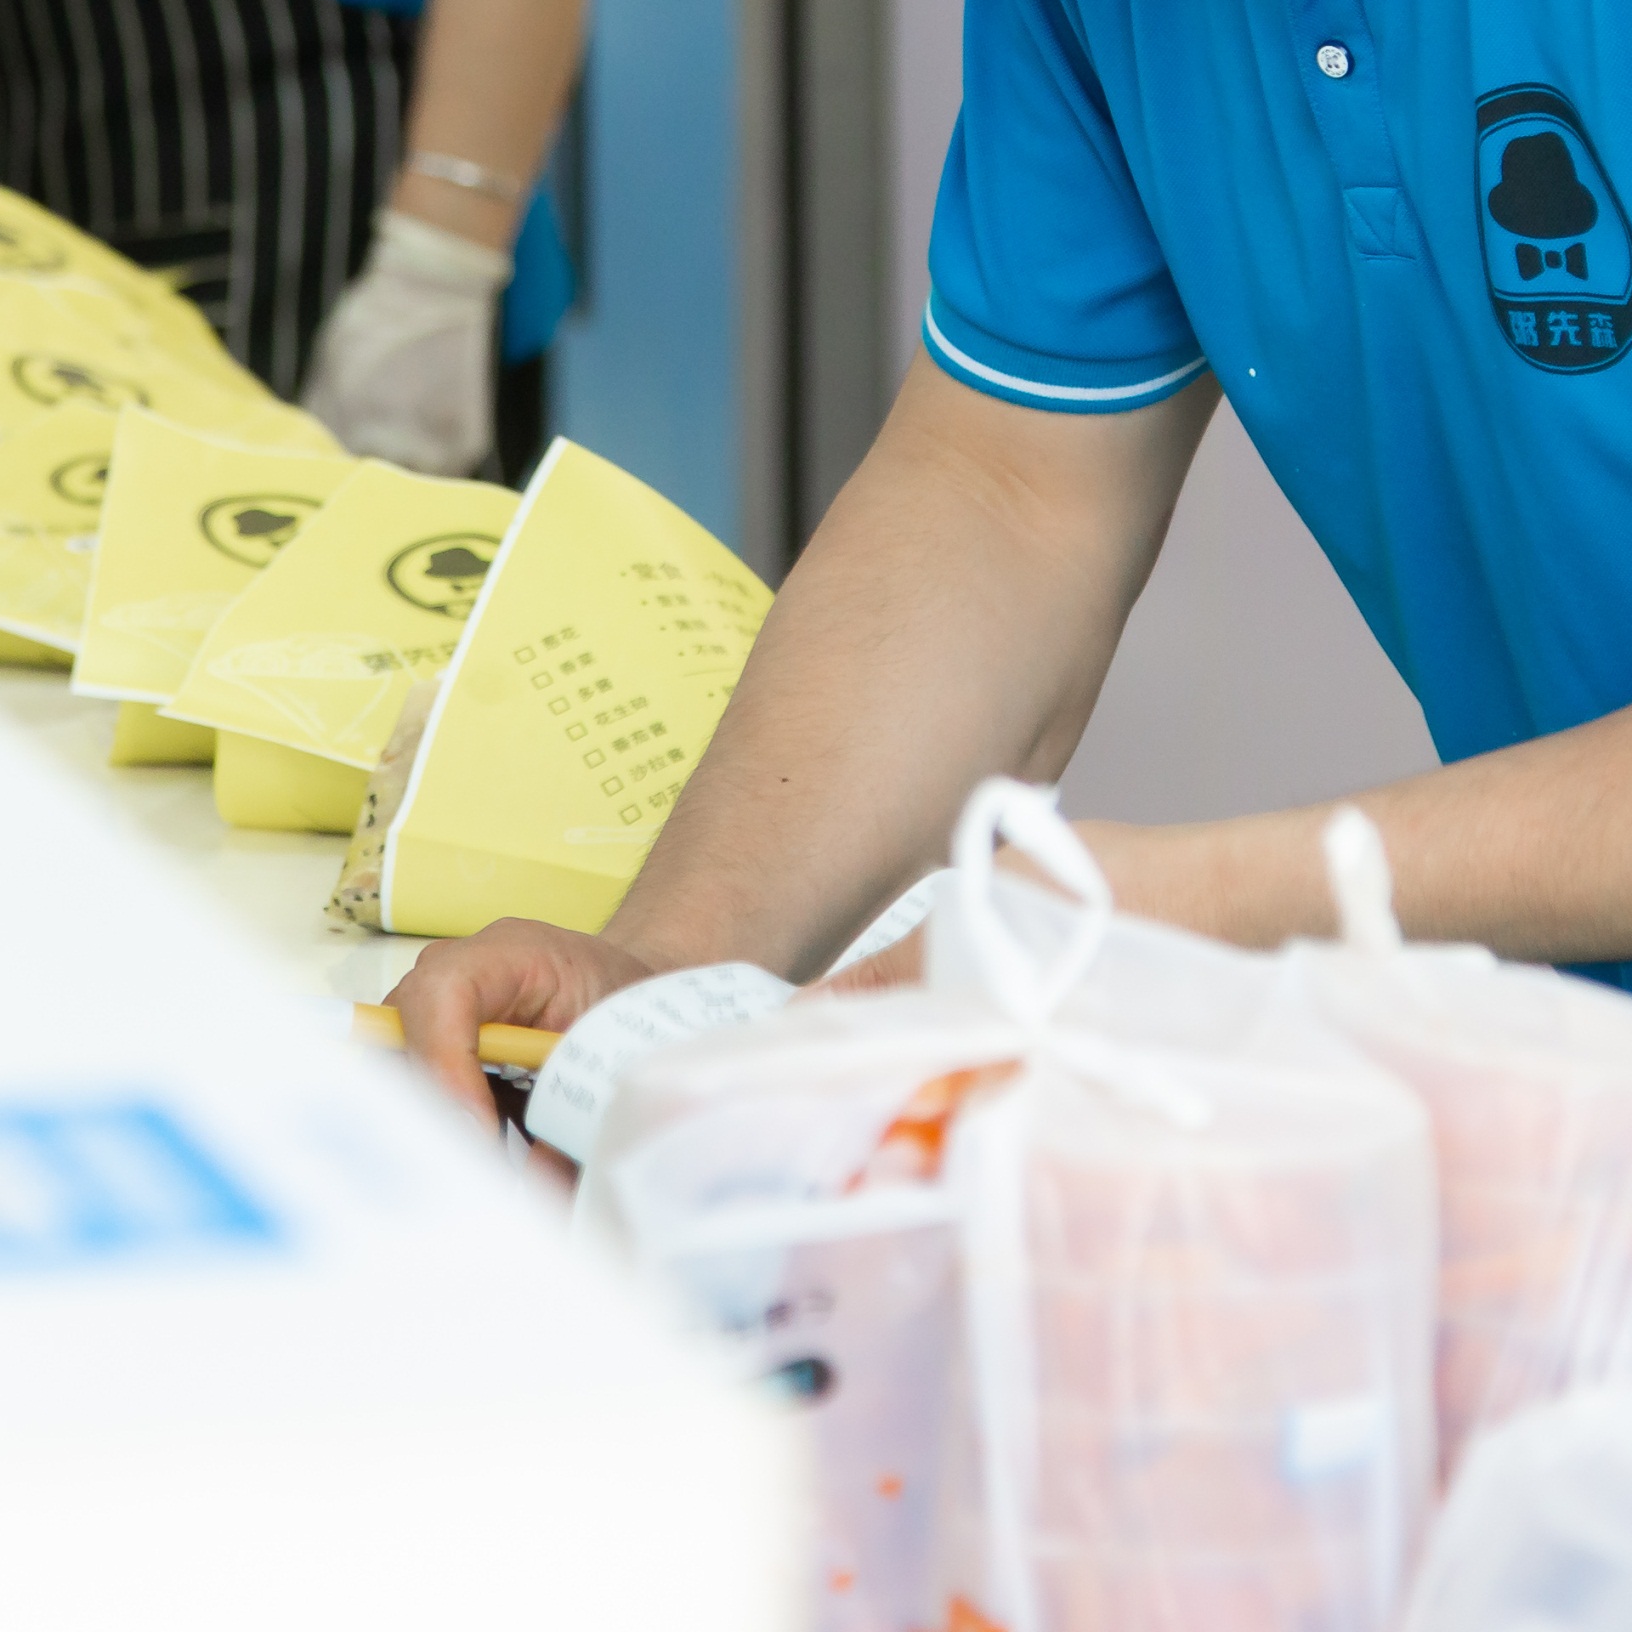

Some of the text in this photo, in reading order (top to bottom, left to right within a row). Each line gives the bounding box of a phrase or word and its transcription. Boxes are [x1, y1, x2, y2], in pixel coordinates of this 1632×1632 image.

[594, 695, 650, 728] 花生碎
[612, 719, 668, 754] 番茄酱
[628, 747, 686, 783] 沙拉酱
